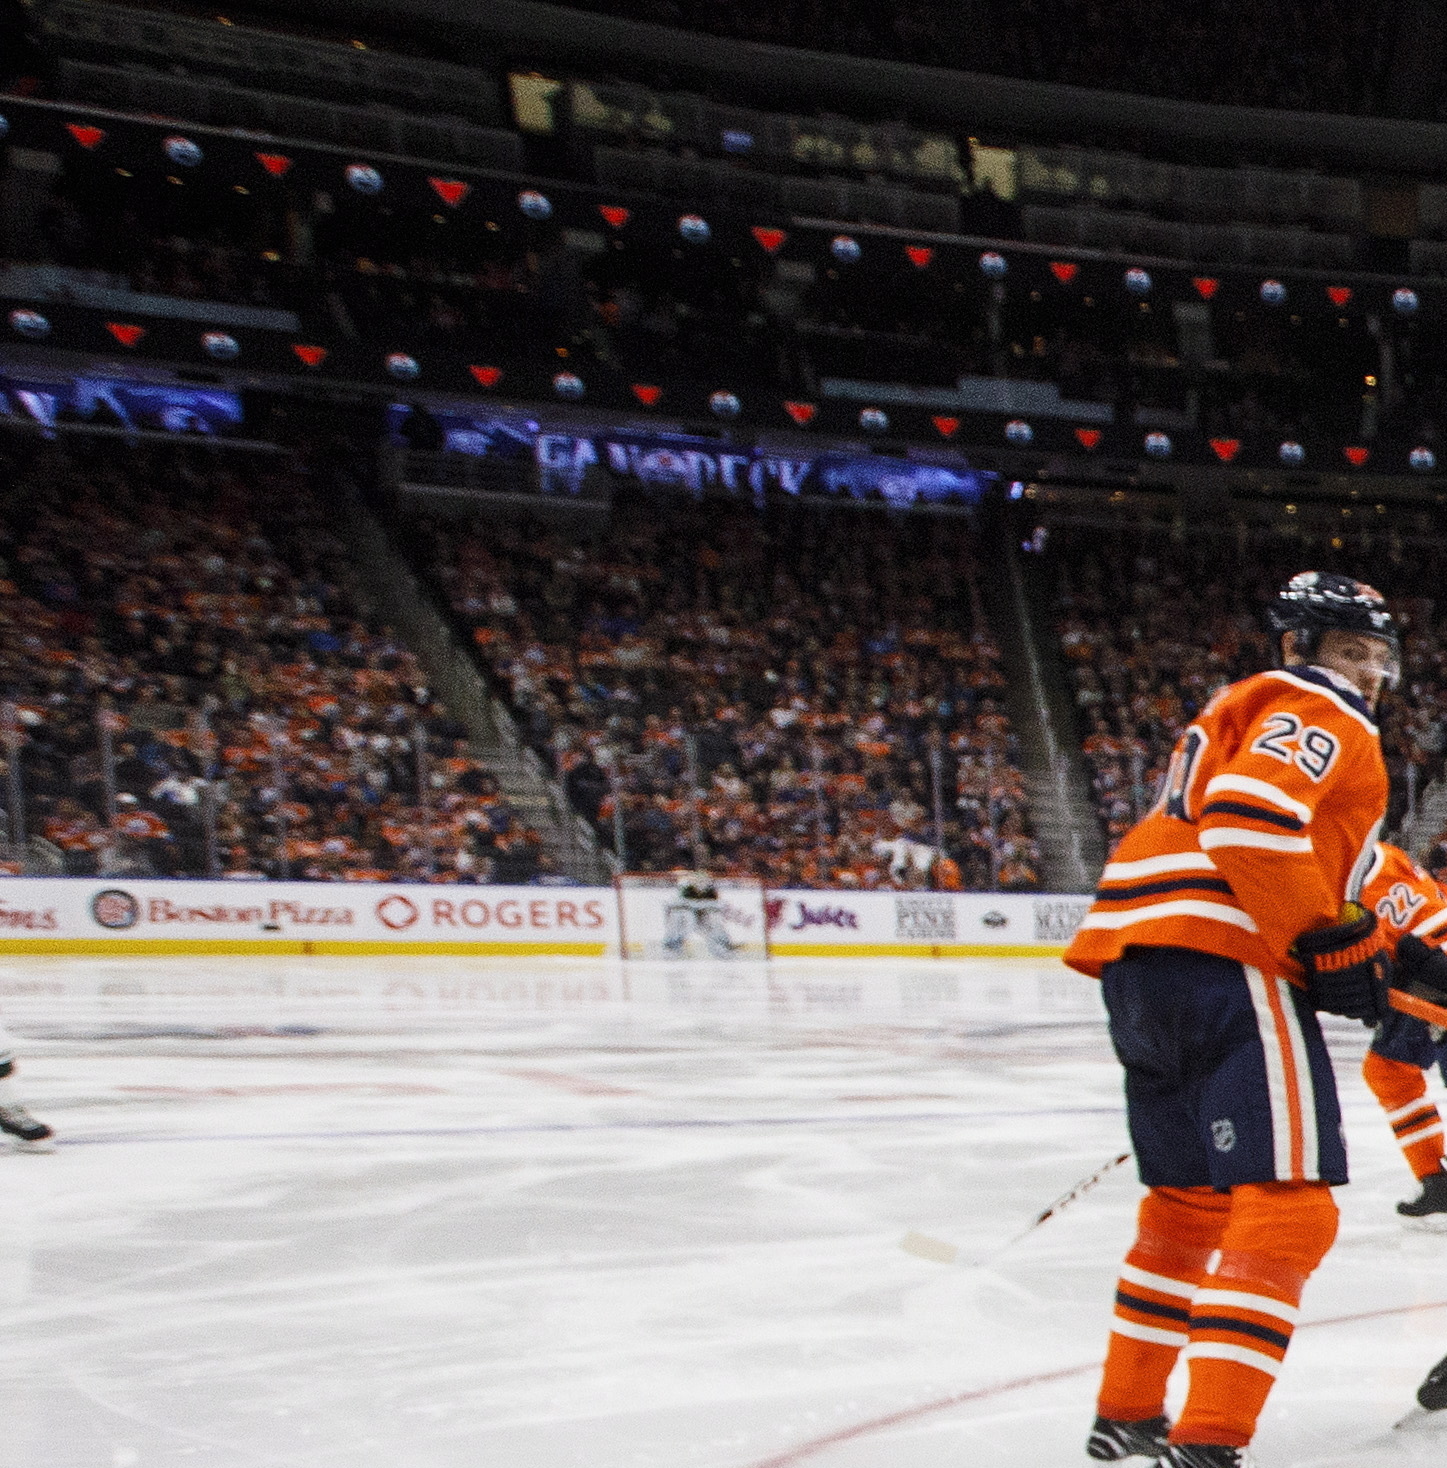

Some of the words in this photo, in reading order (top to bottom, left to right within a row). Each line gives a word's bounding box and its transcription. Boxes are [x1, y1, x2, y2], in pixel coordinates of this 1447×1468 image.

[1251, 712, 1341, 784] 29
[149, 898, 263, 924] Boston
[268, 899, 355, 925] Pizza
[430, 899, 605, 929] ROGERS
[1375, 883, 1427, 928] 22
